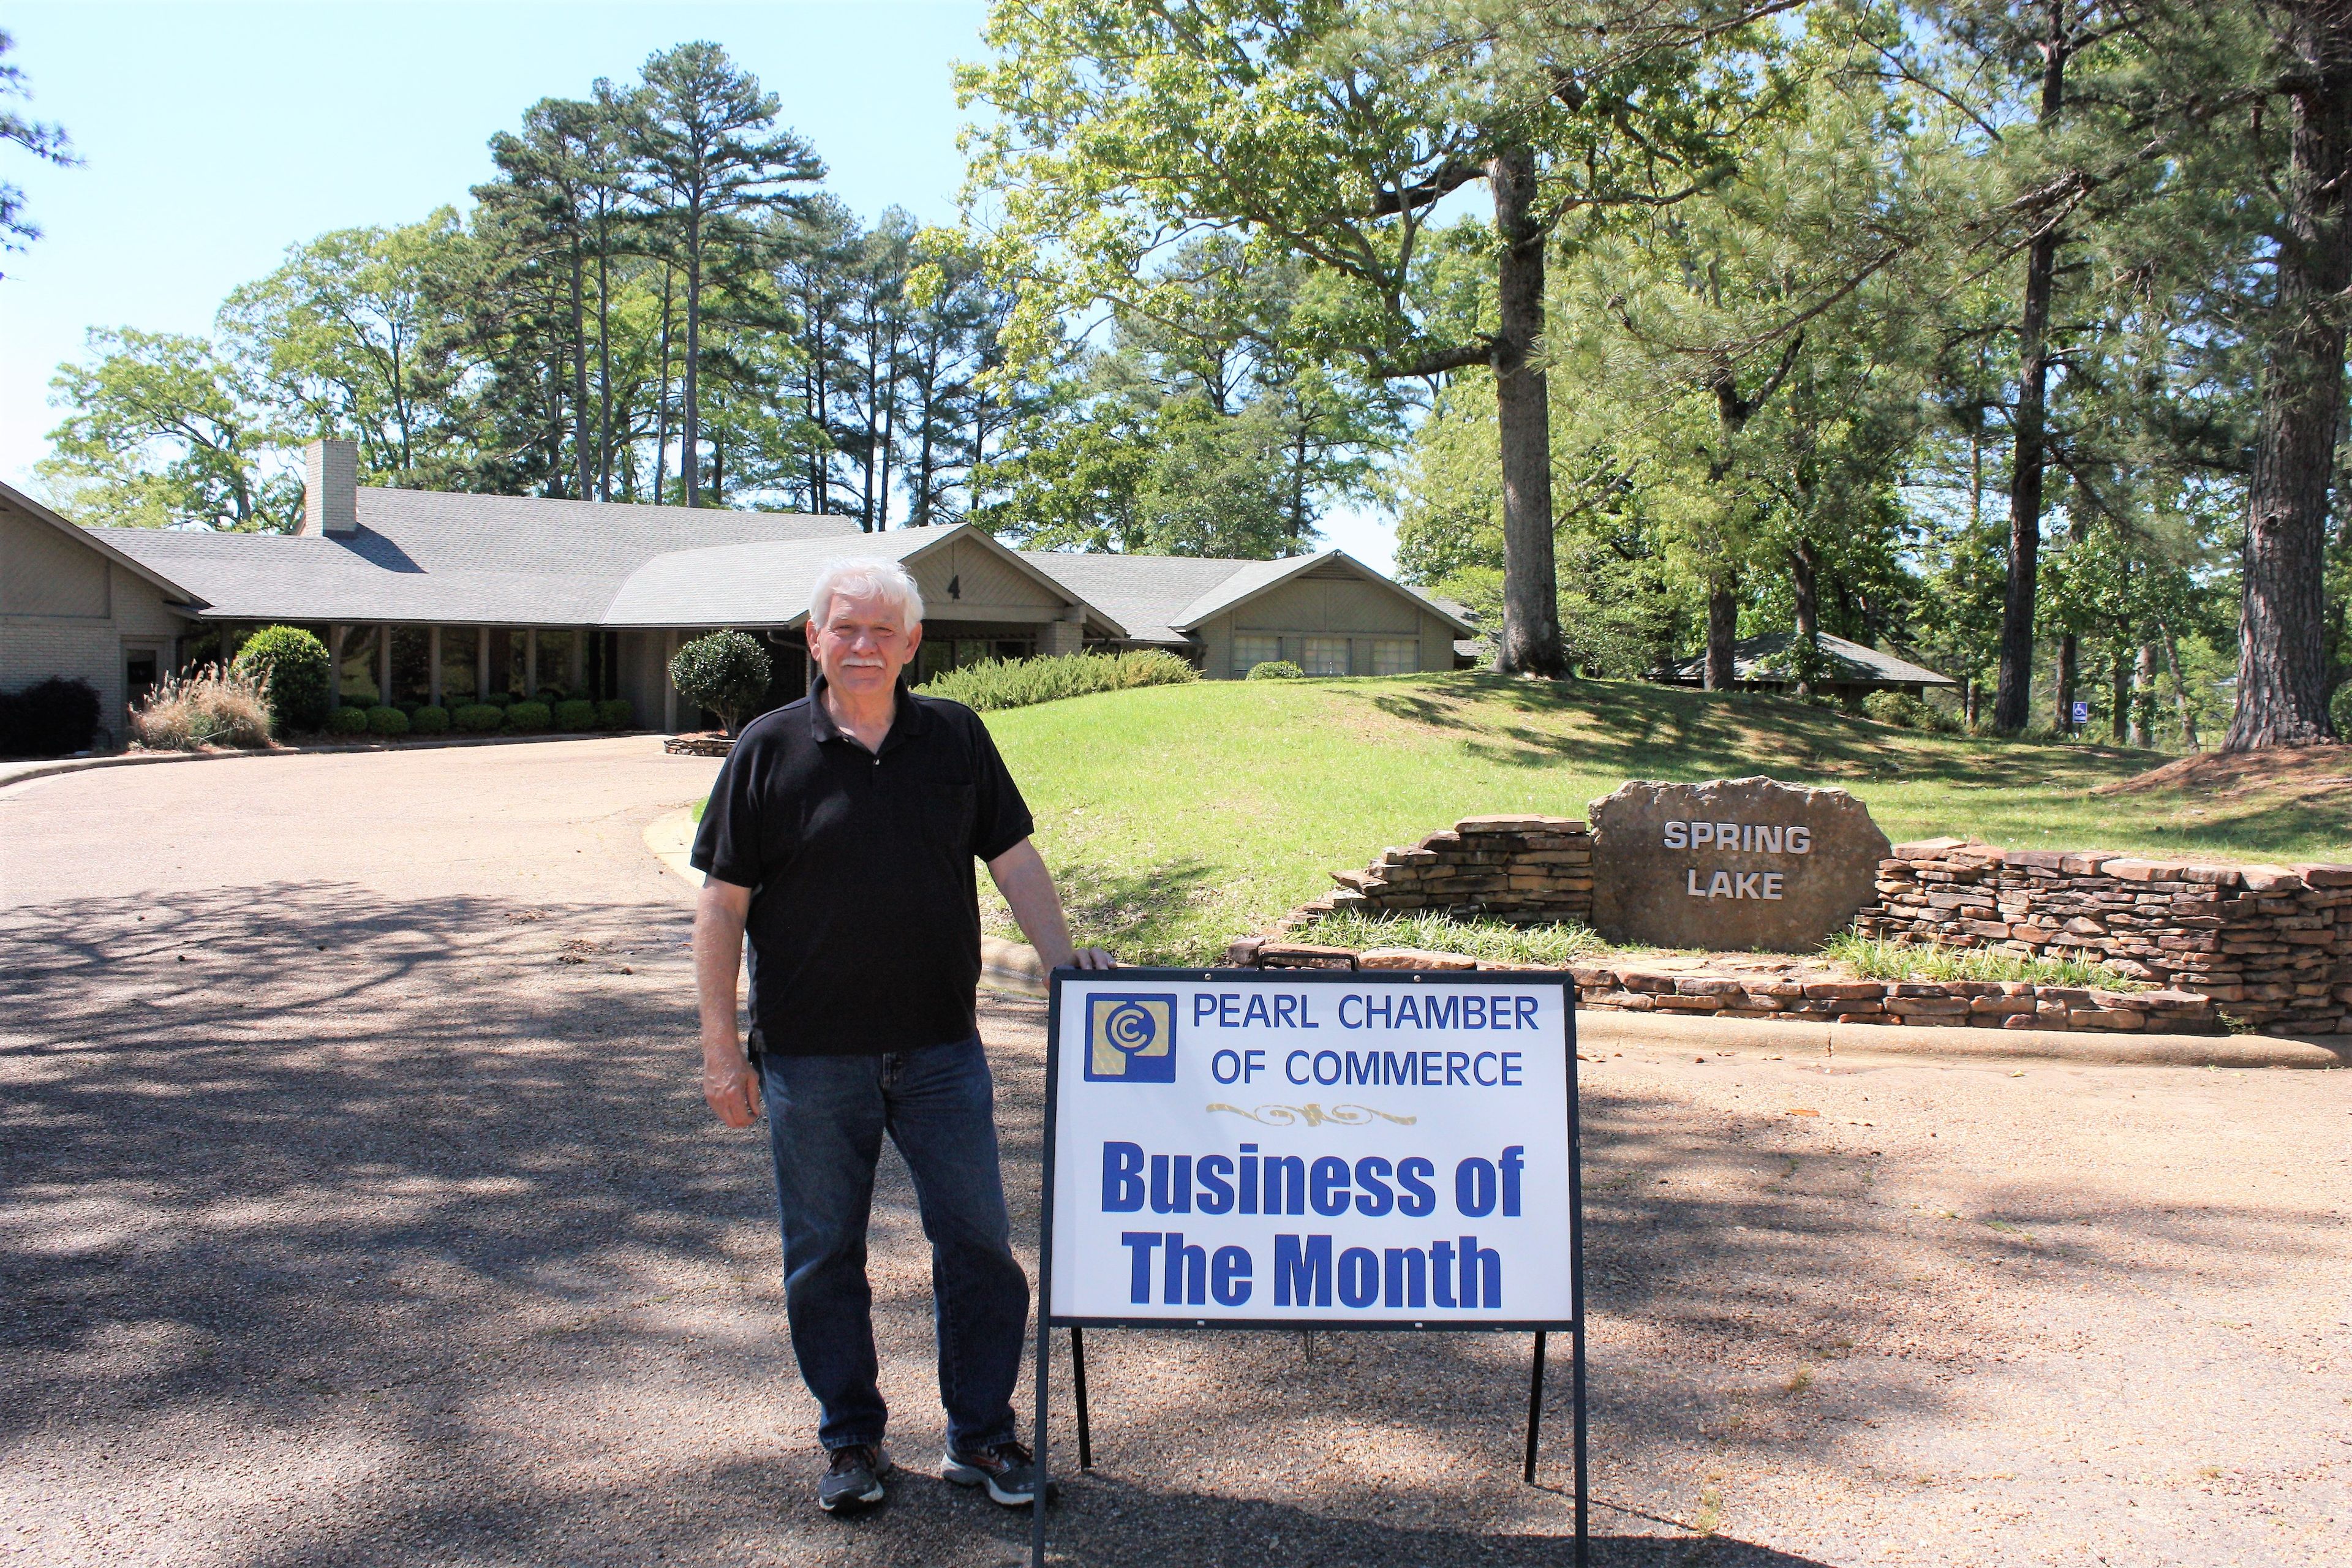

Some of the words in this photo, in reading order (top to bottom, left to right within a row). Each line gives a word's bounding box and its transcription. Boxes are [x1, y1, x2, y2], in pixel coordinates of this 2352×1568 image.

[948, 575, 960, 600] 4
[1664, 820, 1811, 855] SPRING
[1687, 869, 1784, 900] LAKE
[1194, 993, 1319, 1028] PEARL
[1338, 994, 1539, 1030] CHAMBER
[1212, 1049, 1265, 1085] OF
[1285, 1050, 1523, 1087] COMMERCE
[1101, 1141, 1437, 1218] Business
[1455, 1145, 1525, 1218] of
[1120, 1232, 1253, 1307] The
[1273, 1234, 1502, 1310] Month
